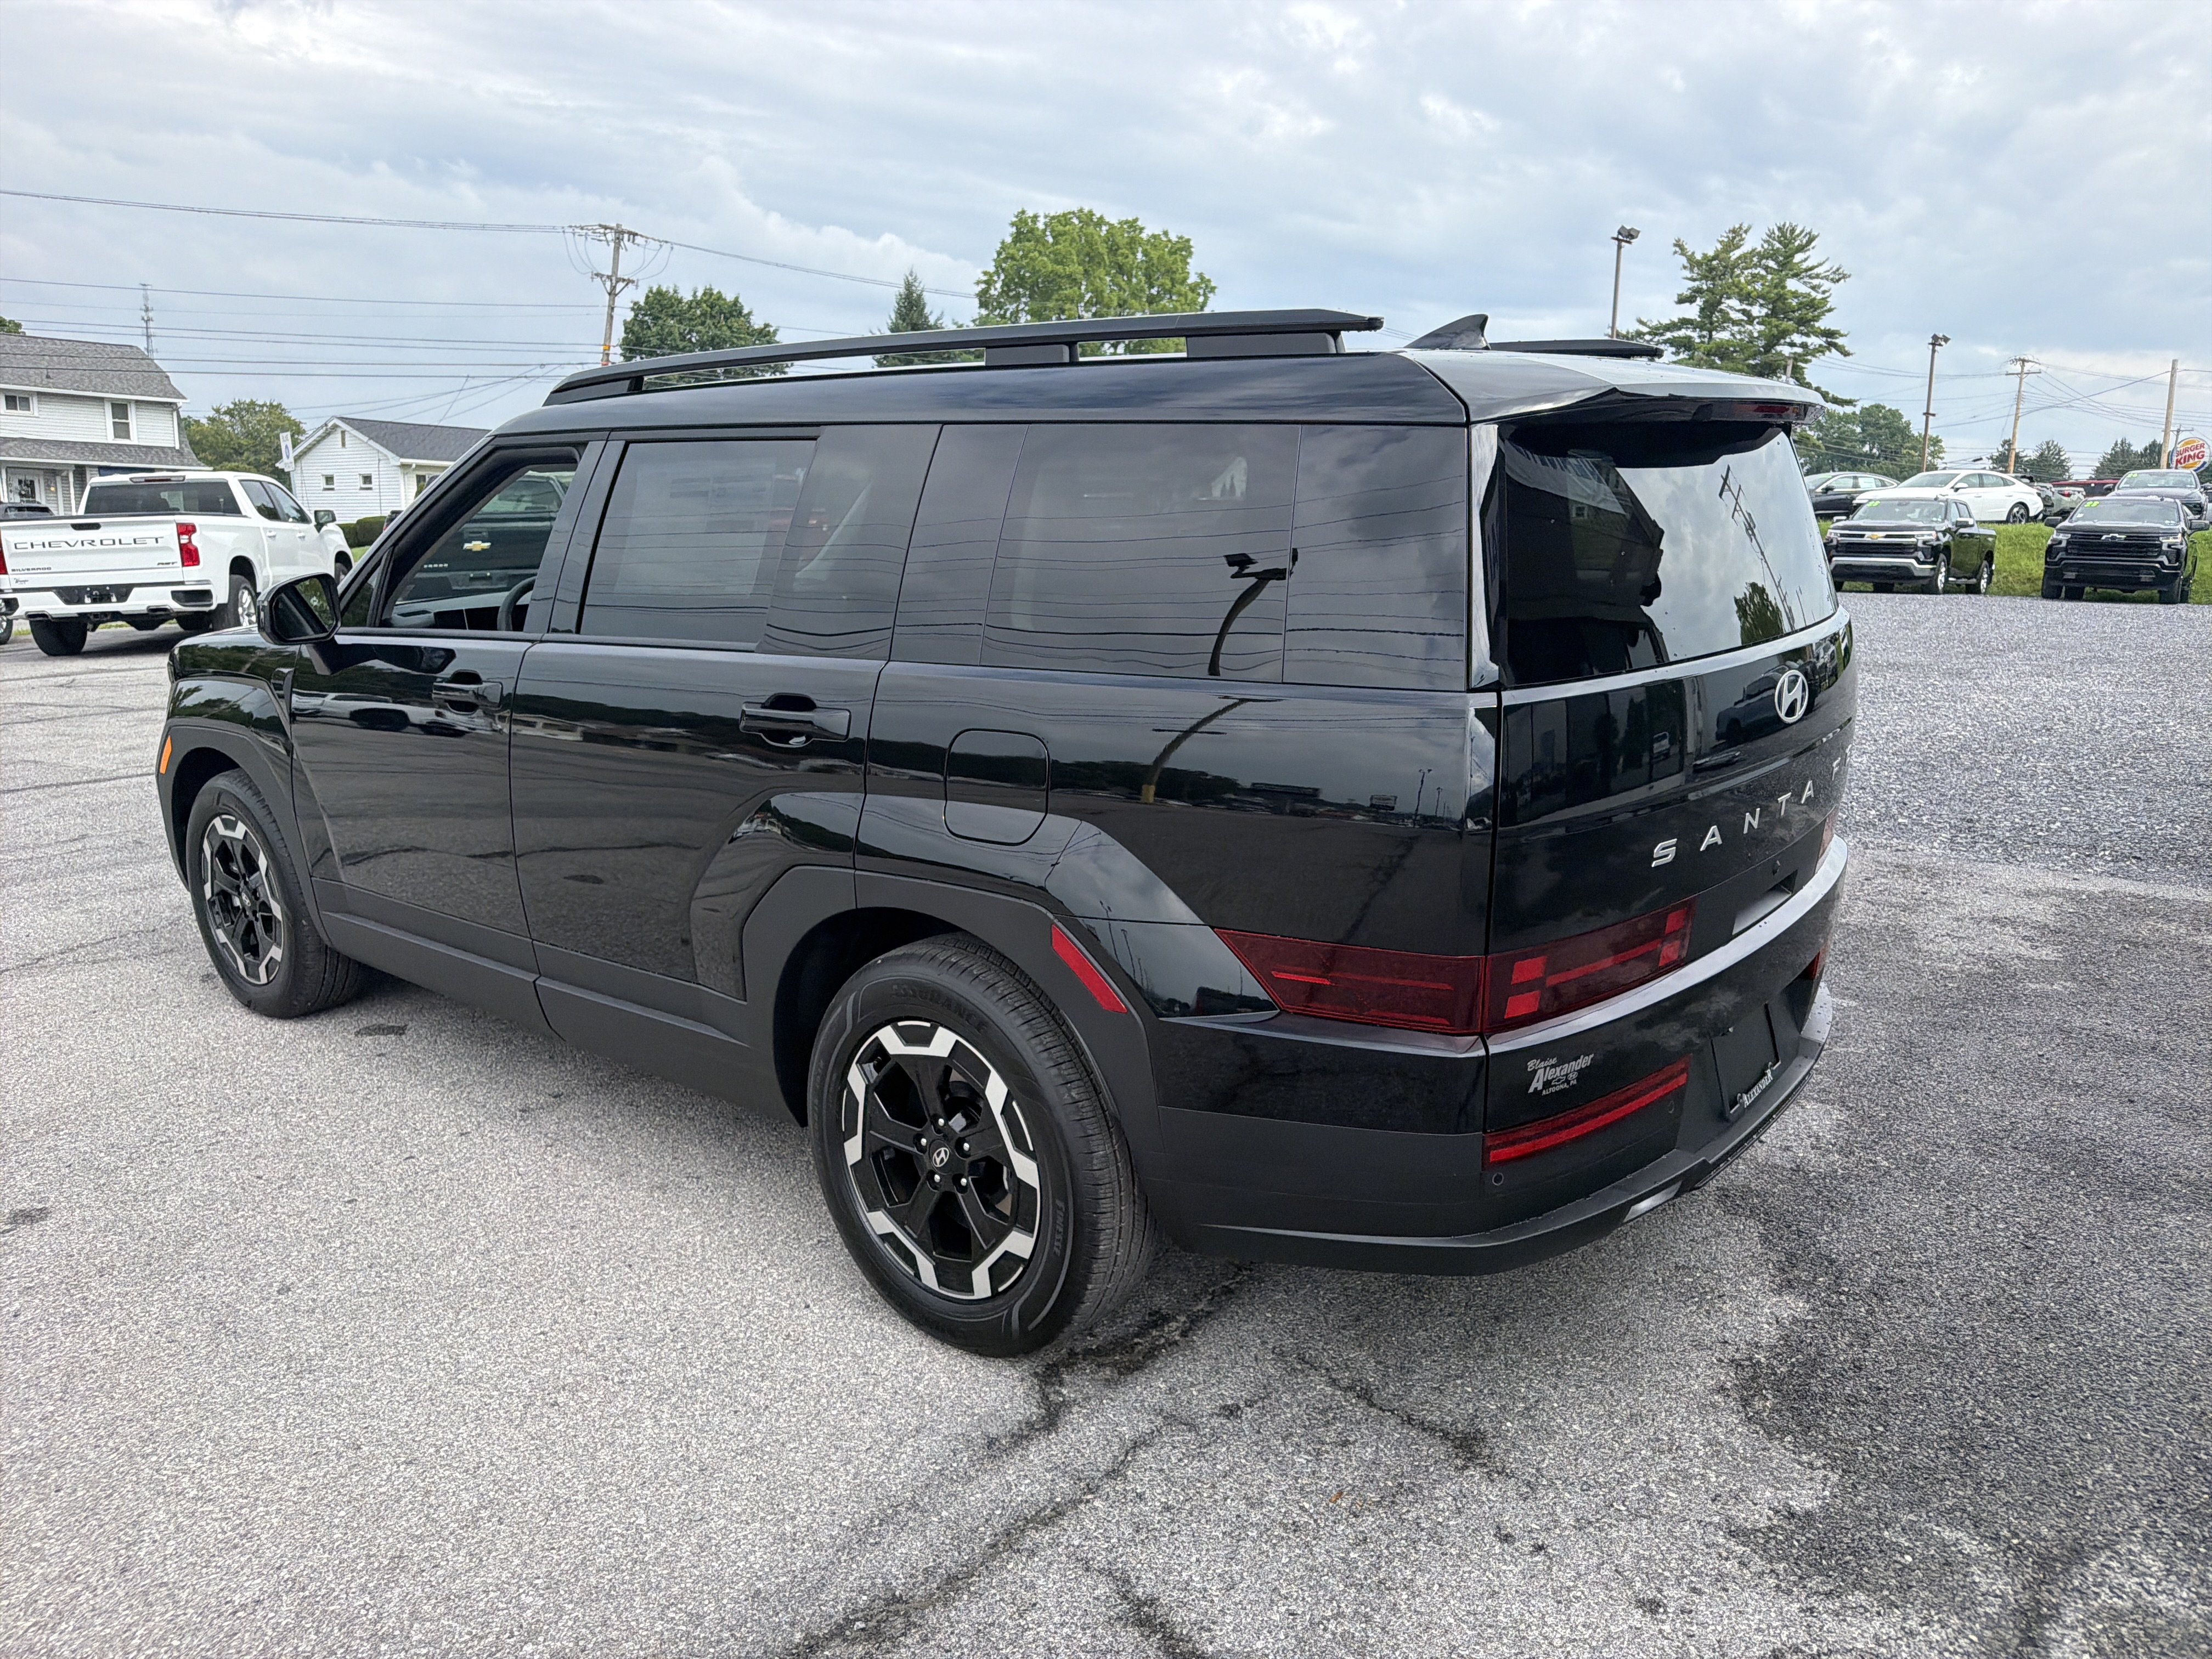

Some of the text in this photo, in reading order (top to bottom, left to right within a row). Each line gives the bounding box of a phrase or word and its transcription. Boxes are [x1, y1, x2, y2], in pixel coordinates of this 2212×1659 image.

[2175, 450, 2205, 466] KING
[2176, 443, 2205, 458] BURGER
[14, 536, 164, 550] CHEVROLET
[1652, 780, 1814, 868] SANTA
[1527, 1057, 1558, 1071] Blaise
[1528, 1053, 1594, 1093] Alexander
